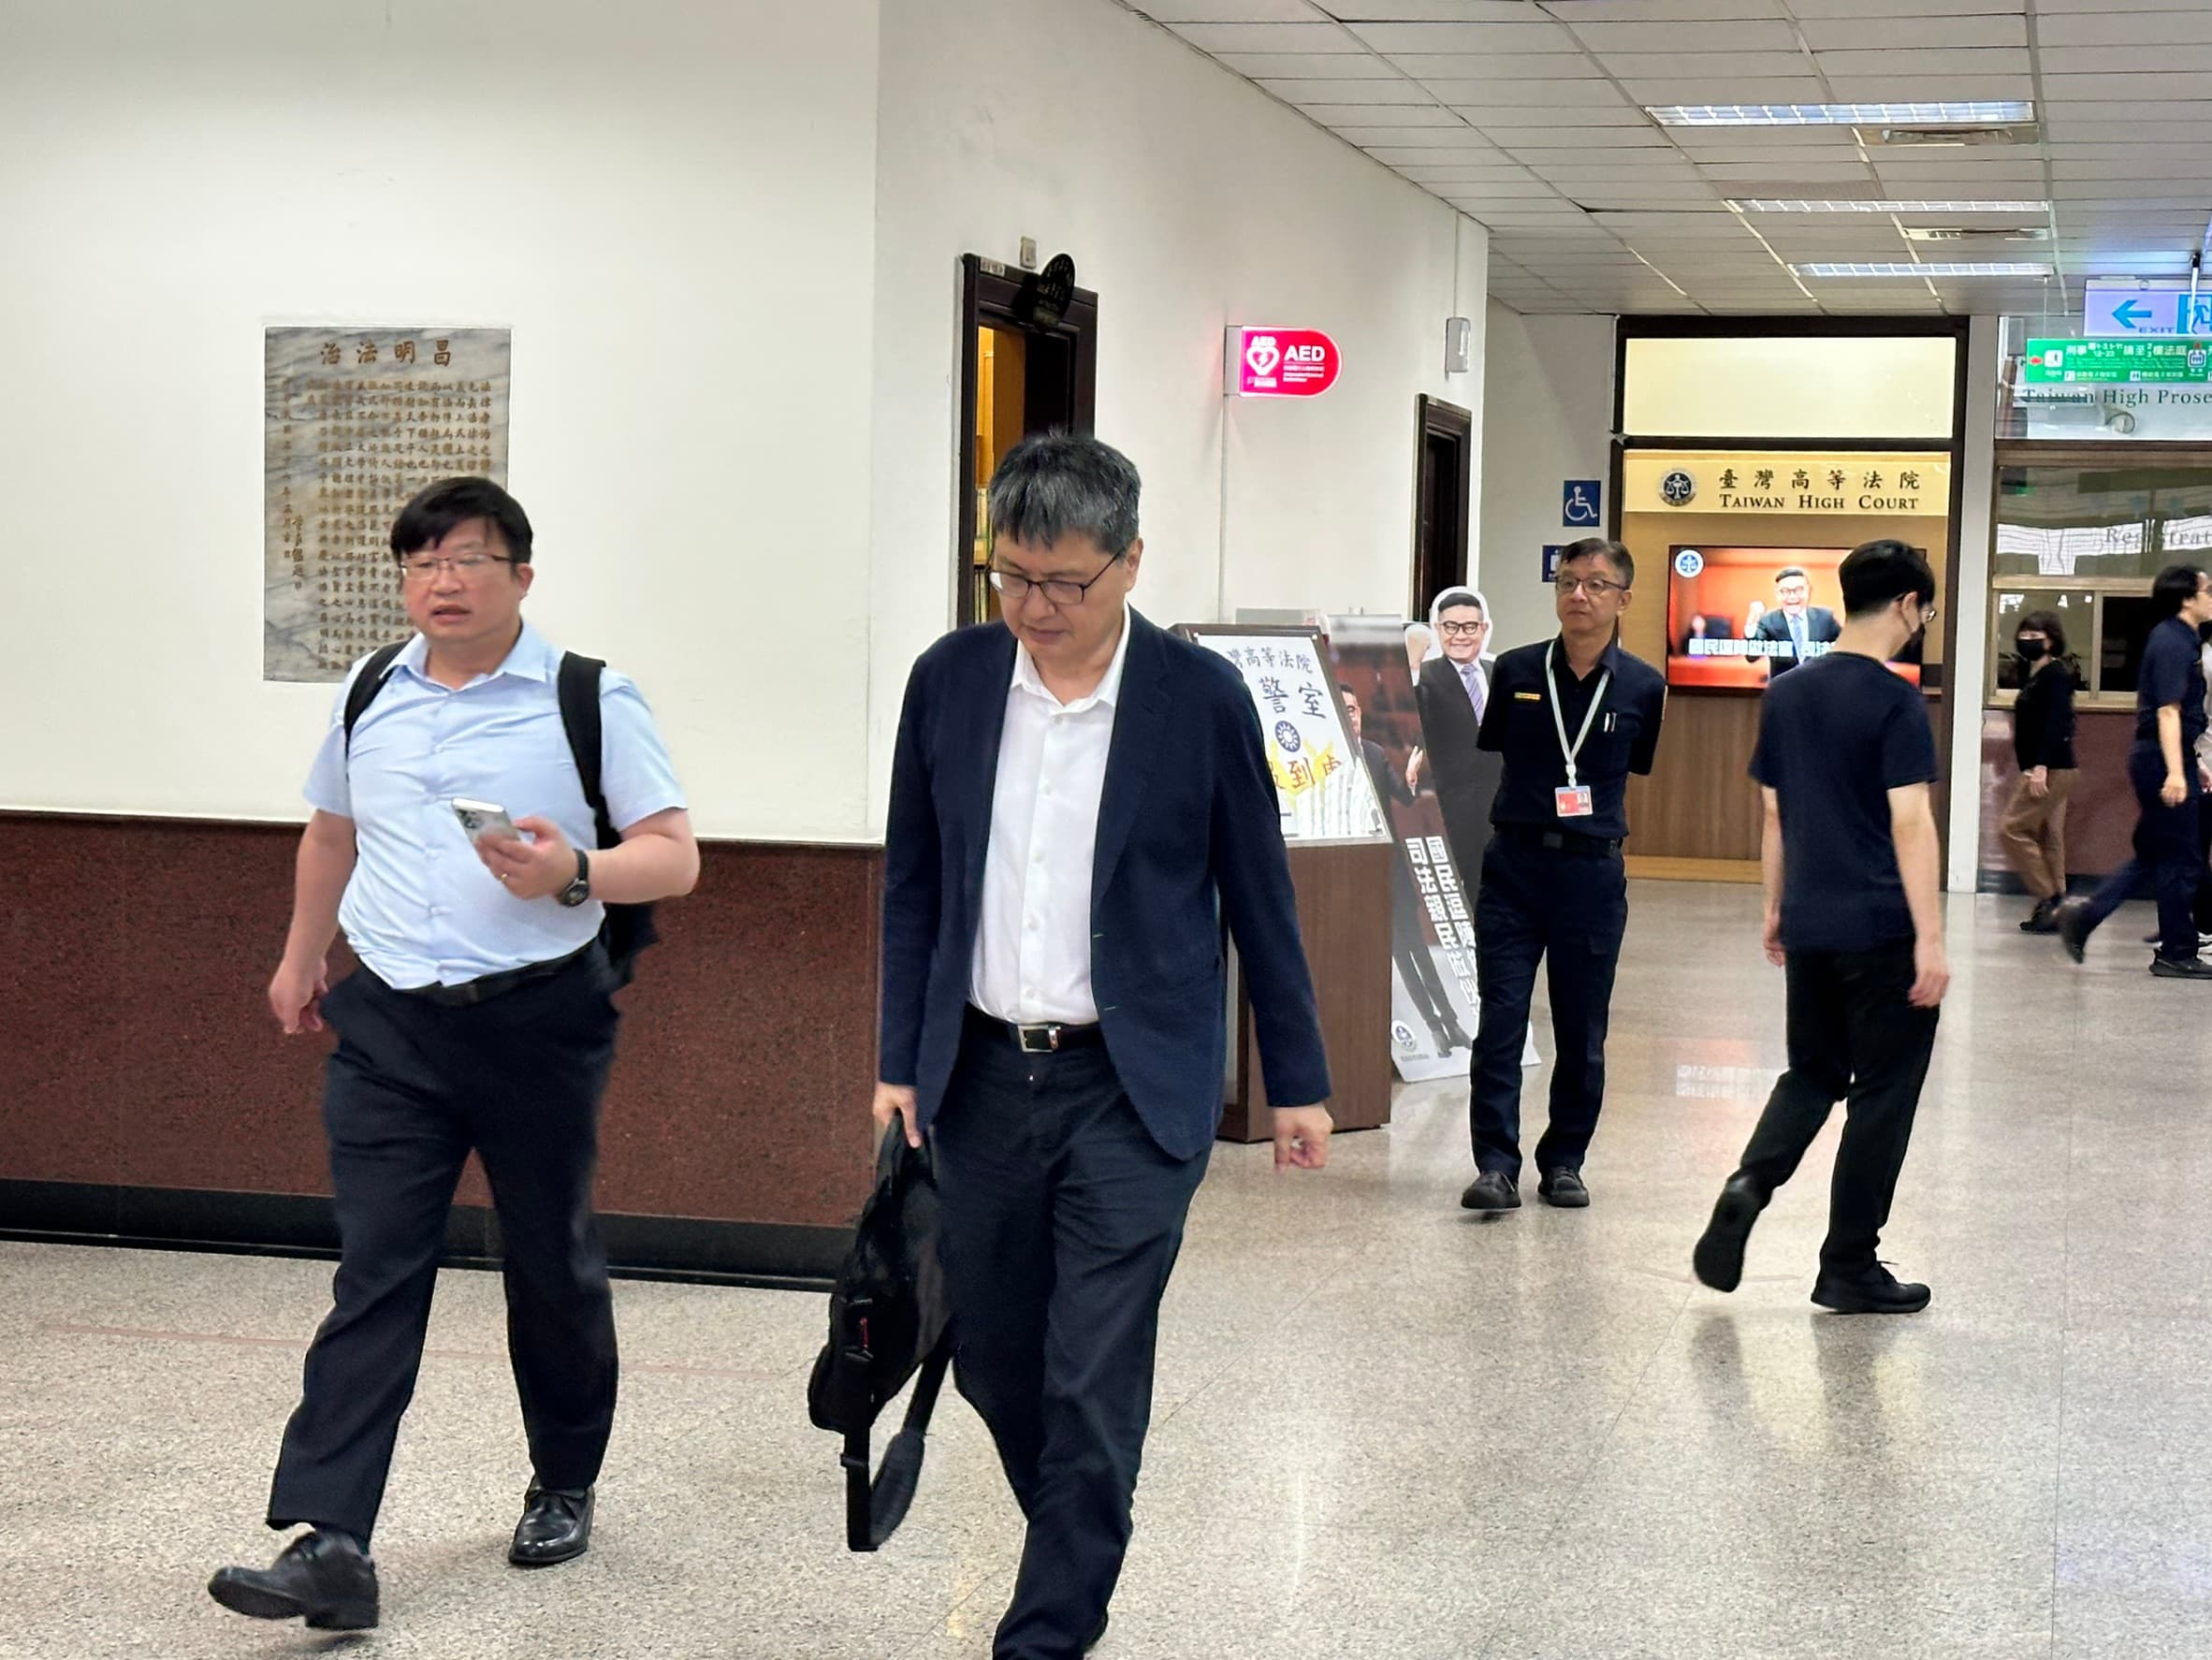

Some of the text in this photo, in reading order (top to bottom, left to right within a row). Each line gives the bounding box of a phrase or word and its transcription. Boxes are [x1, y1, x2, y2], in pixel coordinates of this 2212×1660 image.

[1284, 344, 1326, 361] AED
[2103, 388, 2149, 408] High
[2157, 388, 2212, 404] Prose
[1719, 468, 1920, 490] 臺灣高等法院
[1800, 642, 1836, 657] 司法
[1259, 676, 1327, 719] 警室
